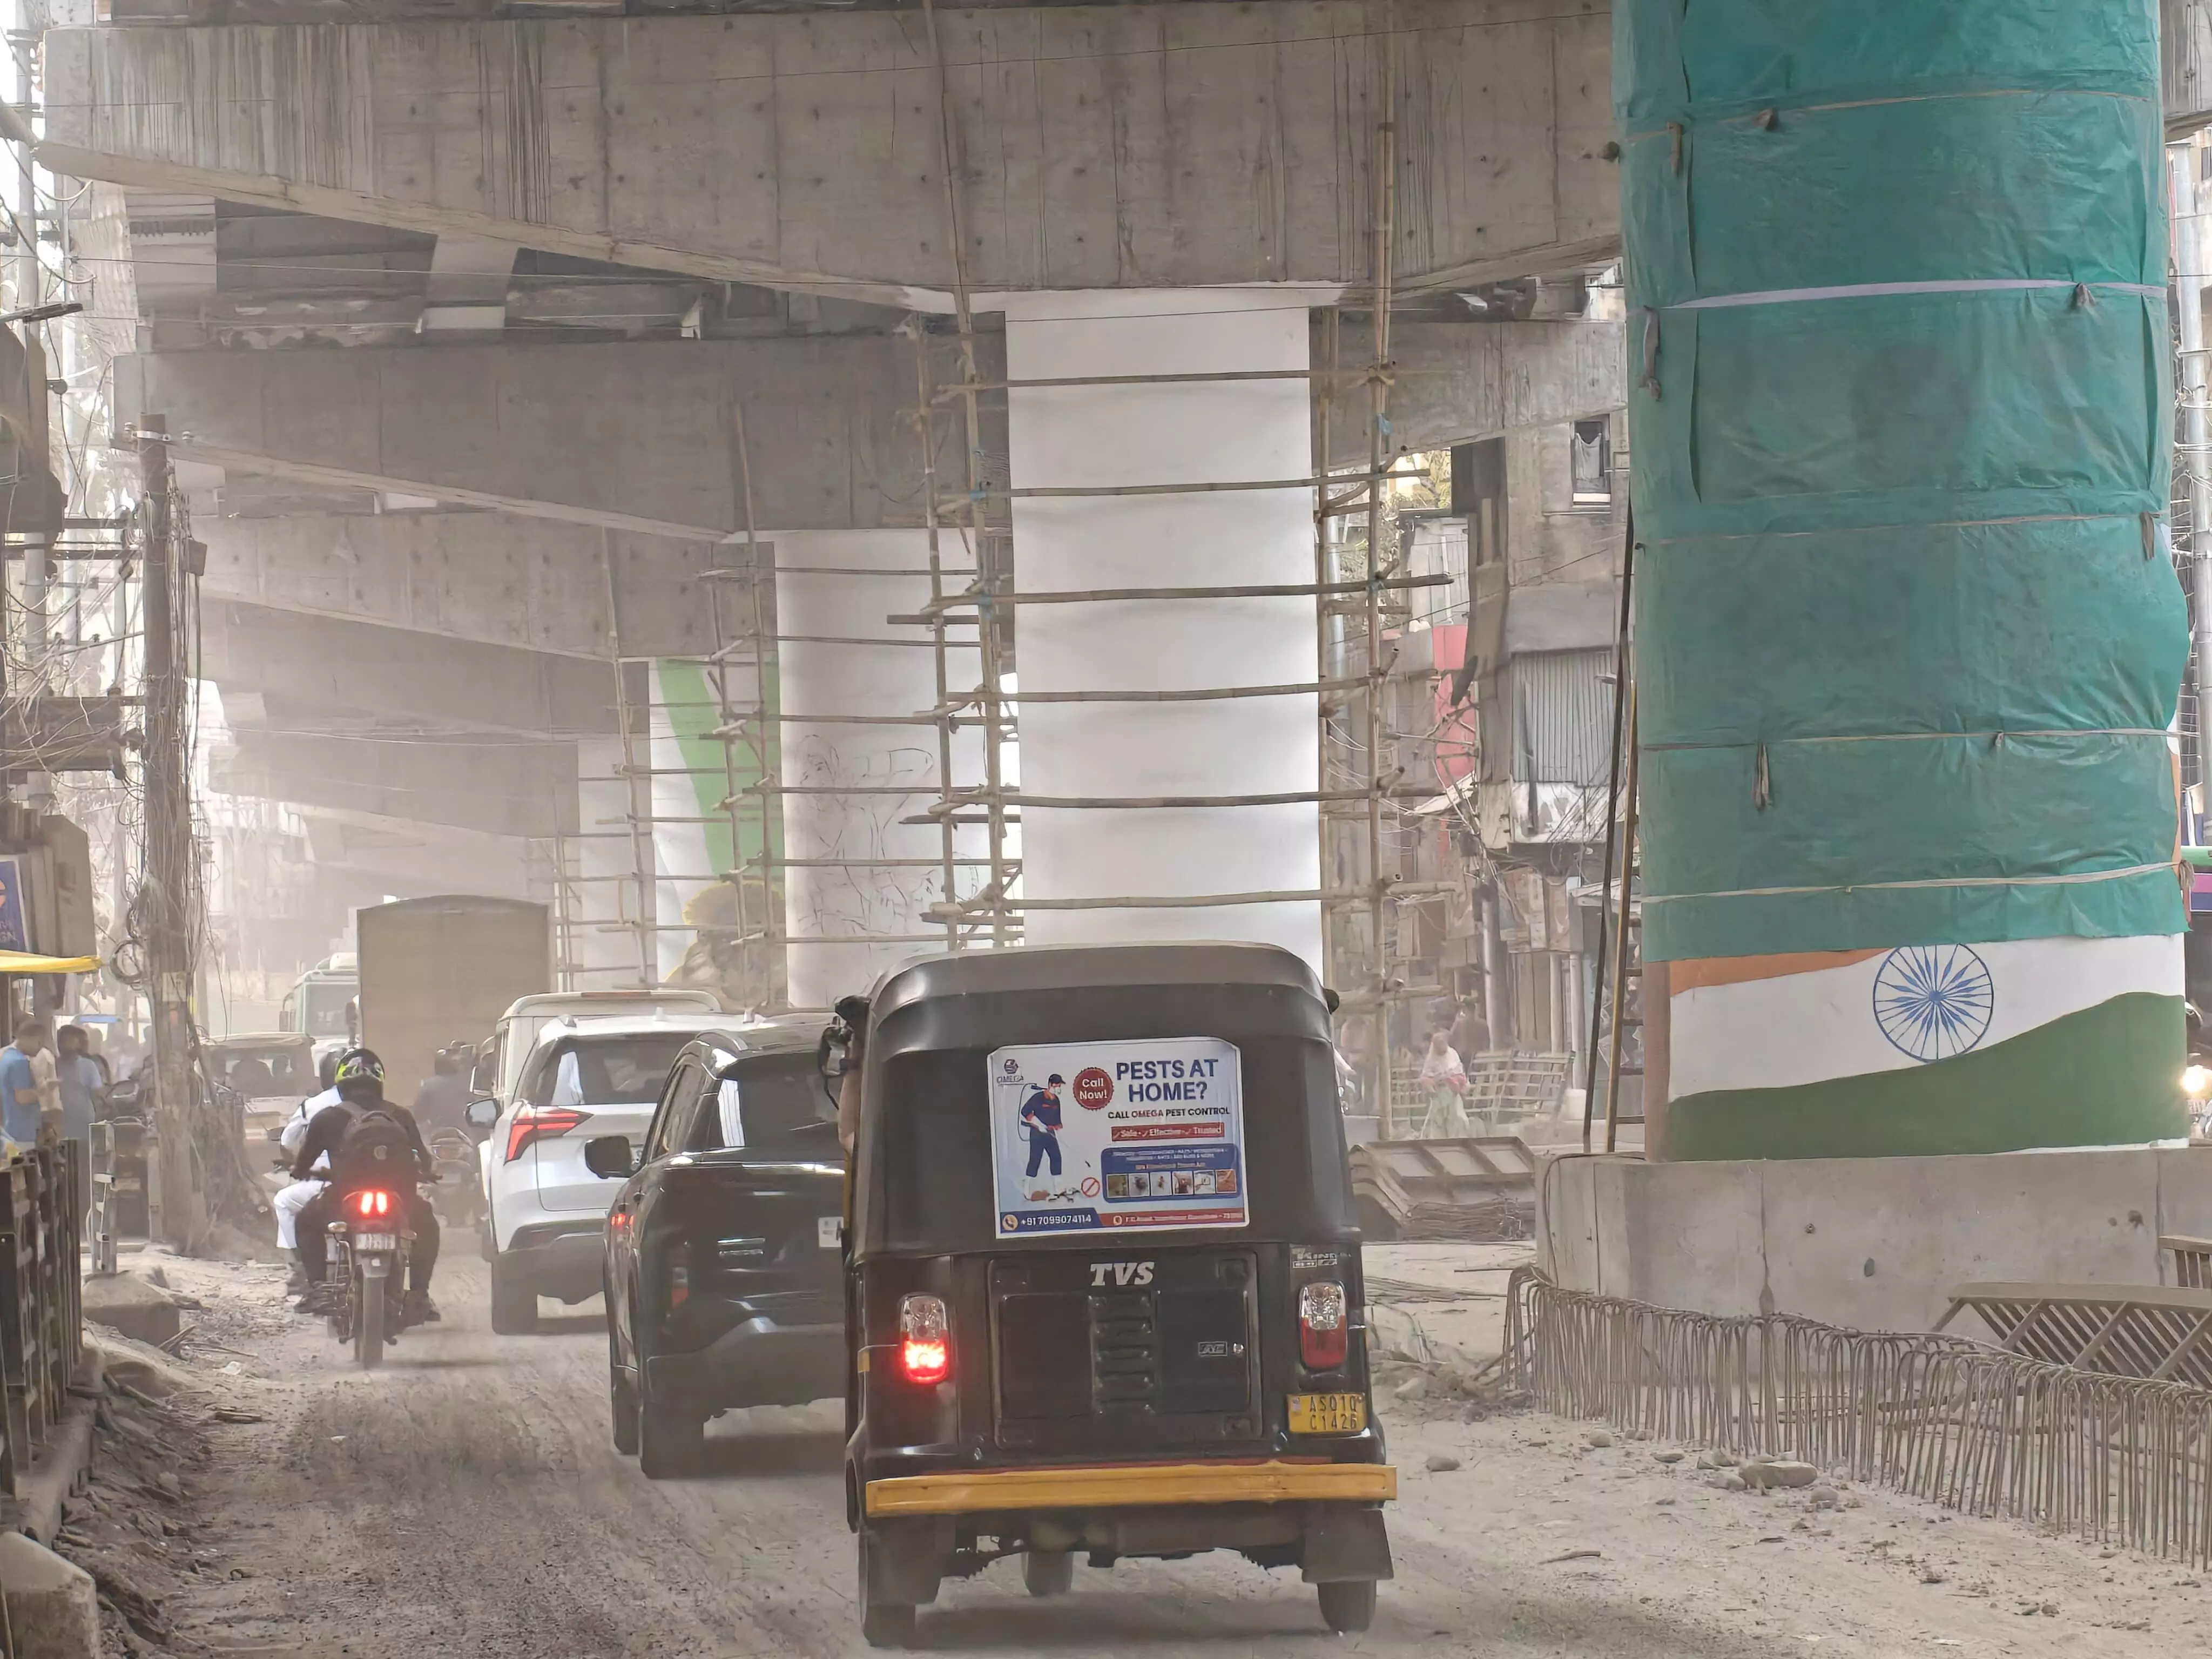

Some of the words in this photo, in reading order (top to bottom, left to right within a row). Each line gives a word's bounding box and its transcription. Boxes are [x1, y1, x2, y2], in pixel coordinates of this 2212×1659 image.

[1116, 1060, 1186, 1080] PESTS
[1189, 1059, 1218, 1077] AT
[1082, 1077, 1104, 1088] Call
[1080, 1089, 1108, 1100] Now!
[1128, 1082, 1208, 1102] HOME?
[1108, 1110, 1129, 1119] CALL
[1131, 1109, 1164, 1118] OMEGA
[1165, 1108, 1186, 1117] PEST
[1188, 1107, 1230, 1116] CONTROL
[1090, 1262, 1155, 1286] TVS
[1310, 1413, 1357, 1430] C1426
